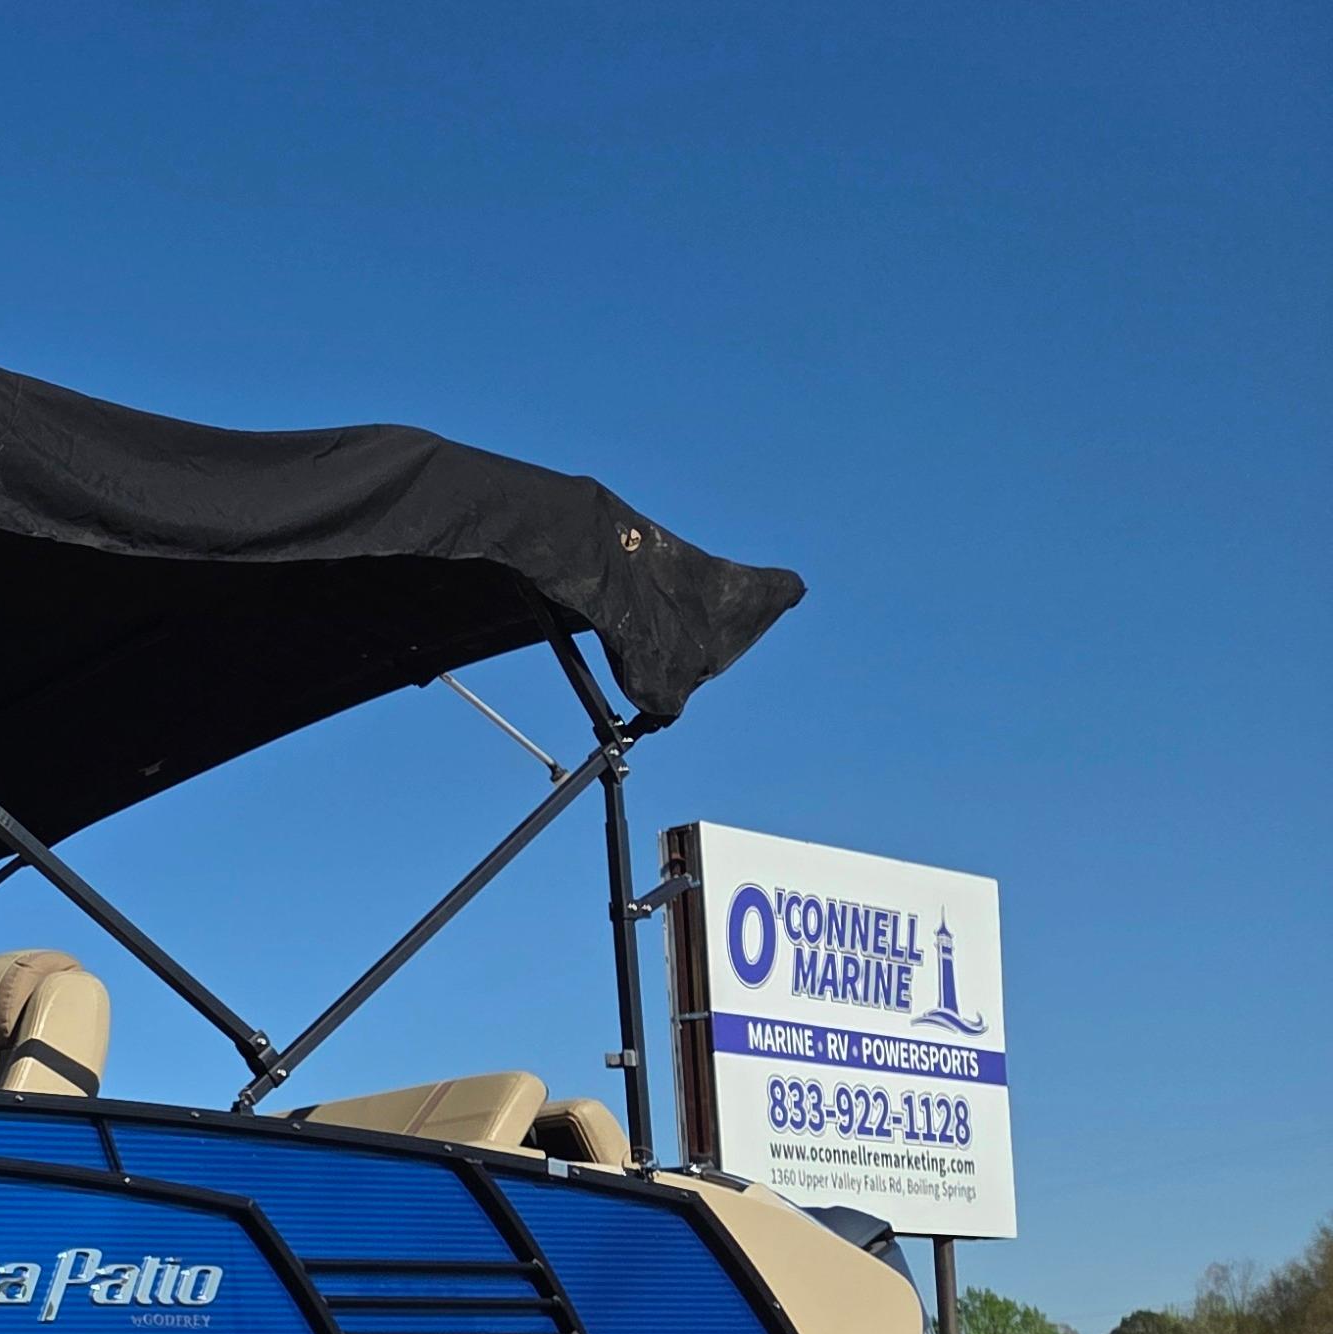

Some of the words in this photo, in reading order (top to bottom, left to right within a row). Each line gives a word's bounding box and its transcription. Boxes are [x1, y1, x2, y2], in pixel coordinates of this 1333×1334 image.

[727, 884, 923, 989] O'CONNELL
[793, 945, 913, 1013] MARINE
[748, 1021, 815, 1057] MARINE
[827, 1033, 849, 1060] RV
[862, 1041, 979, 1078] POWERSPORTS
[769, 1077, 971, 1147] 833-922-1128
[770, 1142, 975, 1178] www.oconnellremarketing.com
[771, 1168, 796, 1186] 1360
[799, 1170, 829, 1190] Upper
[832, 1172, 862, 1195] Valley
[864, 1175, 887, 1193] Falls
[907, 1179, 940, 1201] Boiling
[942, 1182, 976, 1202] Springs
[37, 1248, 223, 1322] Patio
